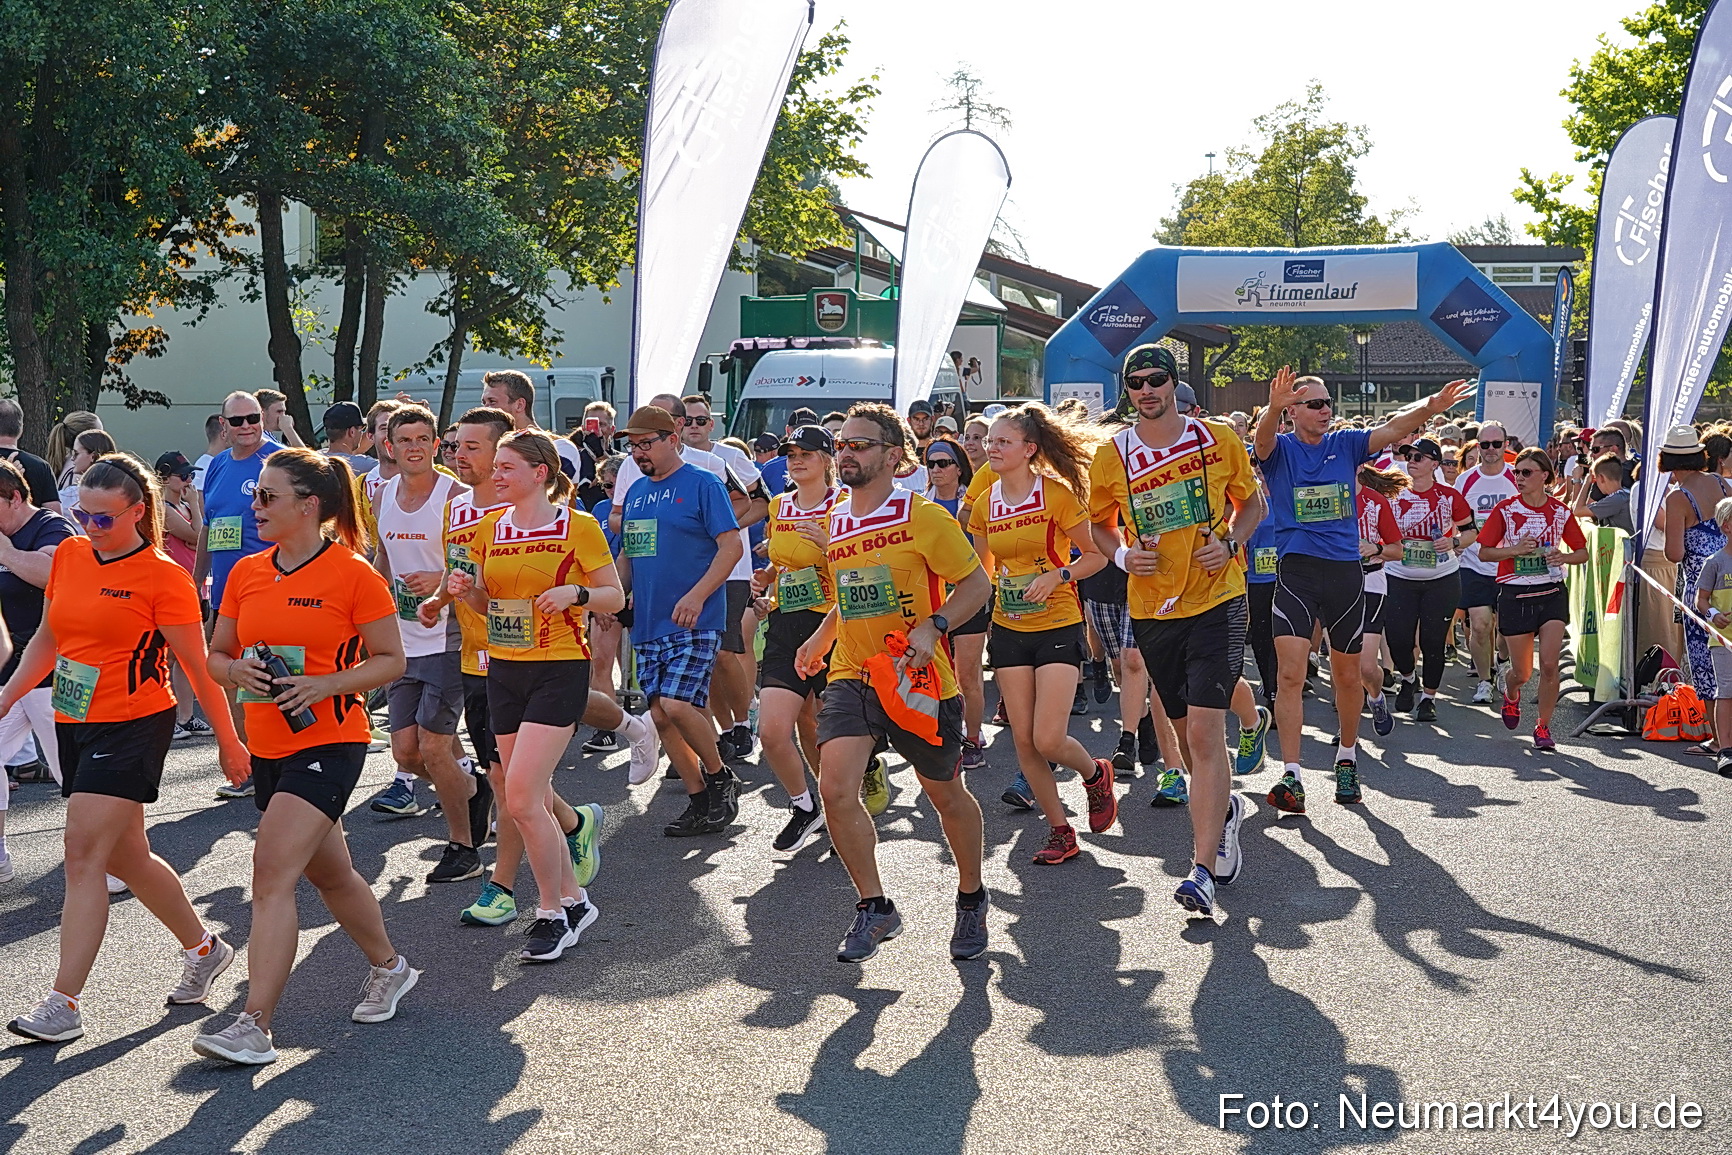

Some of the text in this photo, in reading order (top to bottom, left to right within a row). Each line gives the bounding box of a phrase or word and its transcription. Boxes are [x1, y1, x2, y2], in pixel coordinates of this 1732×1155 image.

[1629, 142, 1672, 246] Fischer
[1292, 267, 1322, 275] Fischer
[1269, 282, 1359, 300] firmenlauf
[1098, 312, 1146, 323] Fischer
[755, 376, 795, 386] abavent
[1132, 452, 1223, 495] MAX BÖGL
[1144, 501, 1176, 521] 808
[1180, 499, 1191, 520] 2022
[1305, 497, 1330, 510] 449
[988, 521, 1013, 534] MAX
[1015, 515, 1049, 528] BÖGL
[1166, 513, 1184, 523] Daniel
[213, 527, 235, 540] 1762
[776, 524, 796, 532] MAX
[488, 547, 521, 558] MAX
[525, 542, 566, 554] BÖGL
[828, 530, 914, 563] MAX BÖGL
[1407, 549, 1432, 560] 1106
[1520, 557, 1547, 567] 1118
[100, 588, 131, 599] THULE
[785, 583, 809, 599] 803
[850, 584, 879, 602] 809
[885, 584, 896, 606] 2022
[288, 598, 323, 608] THULE
[848, 602, 867, 610] Möckel
[490, 616, 523, 632] 1644
[56, 675, 84, 701] 1396
[79, 688, 91, 714] 2022
